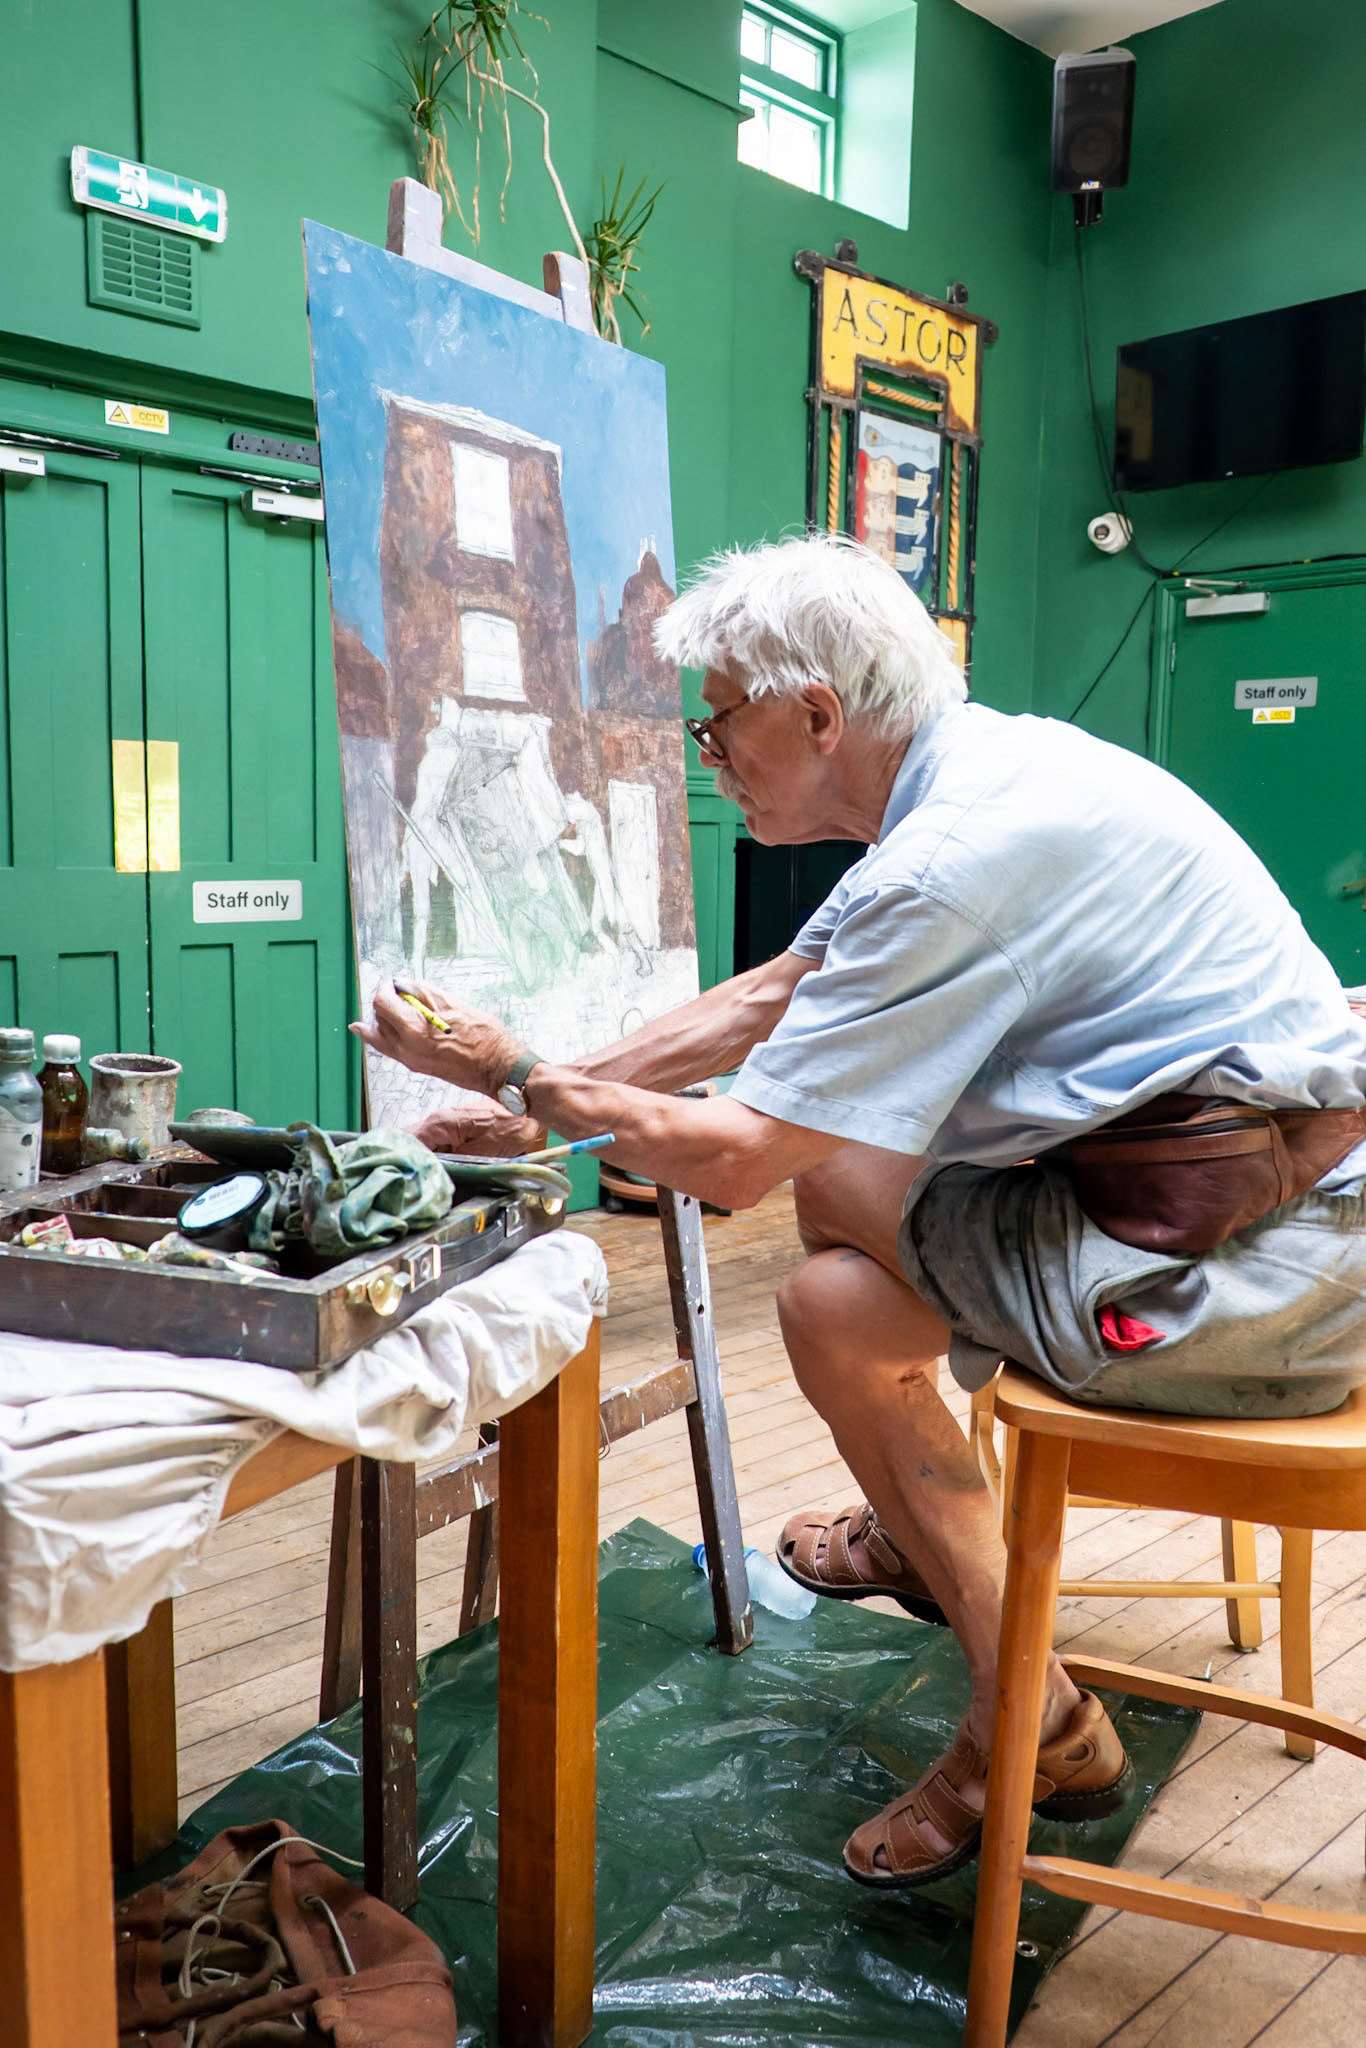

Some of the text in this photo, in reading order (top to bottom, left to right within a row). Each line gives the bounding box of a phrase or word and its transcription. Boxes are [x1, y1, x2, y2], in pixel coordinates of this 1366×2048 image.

[833, 288, 967, 376] ASTOR
[138, 411, 164, 424] CCTV
[1244, 684, 1307, 700] Staff only
[207, 891, 289, 911] Staff only
